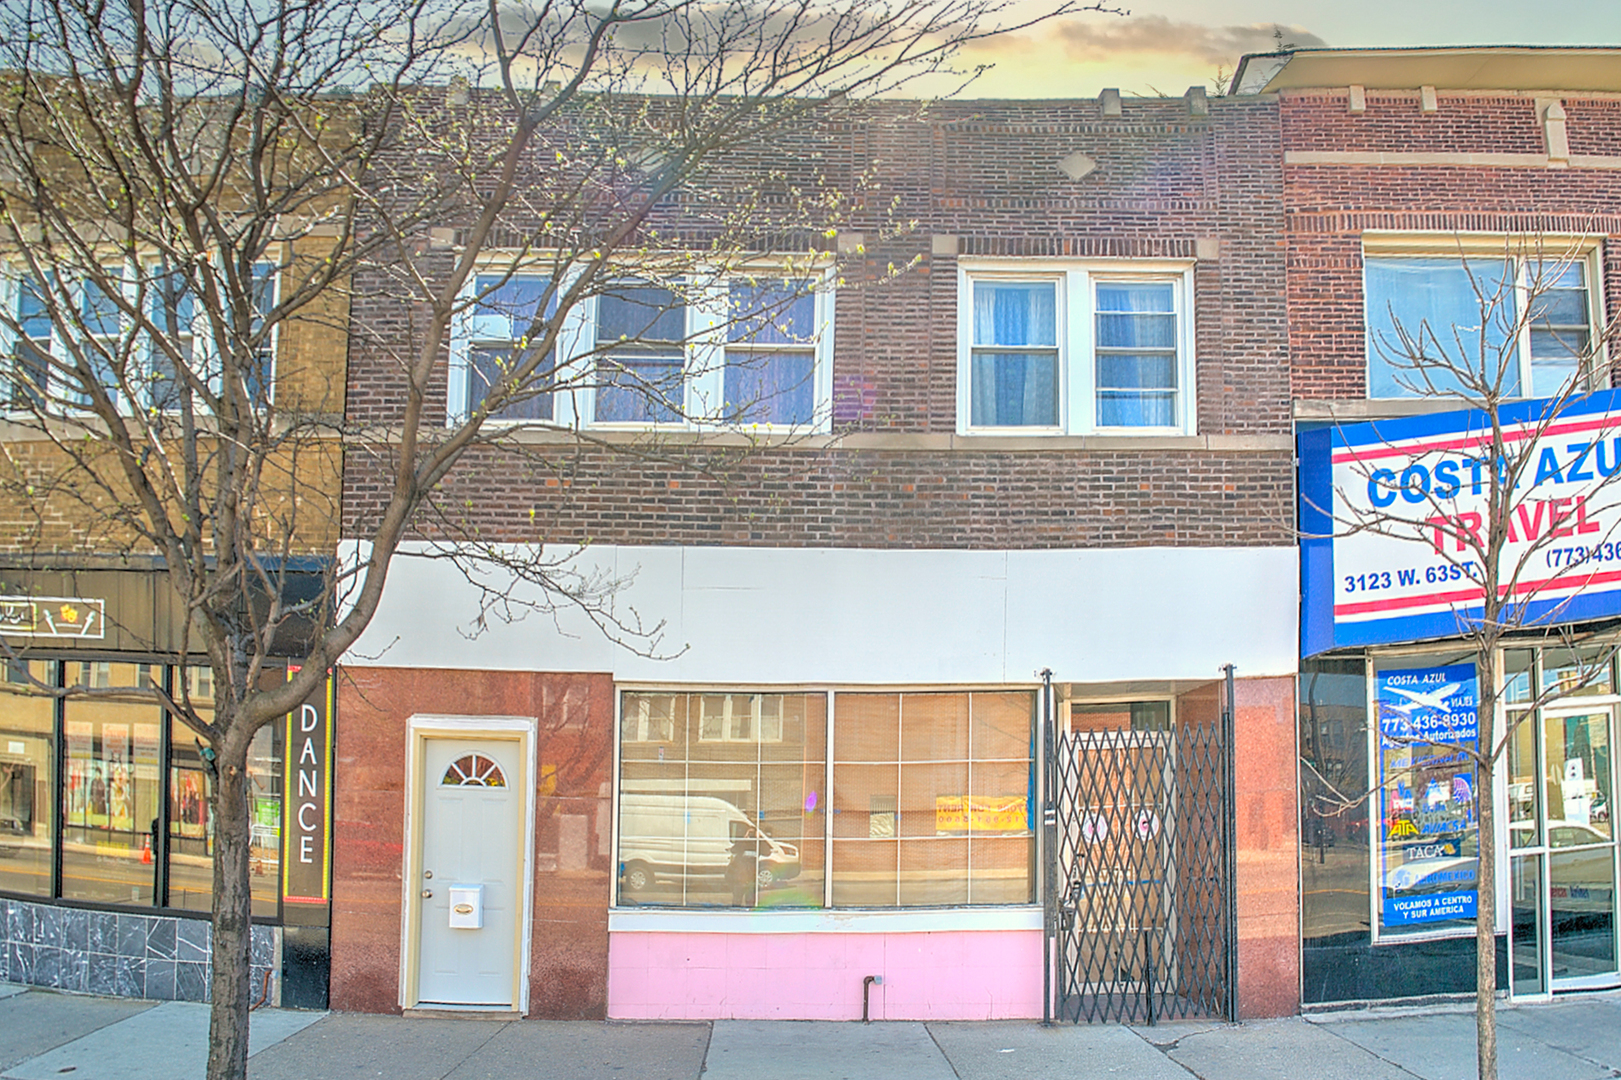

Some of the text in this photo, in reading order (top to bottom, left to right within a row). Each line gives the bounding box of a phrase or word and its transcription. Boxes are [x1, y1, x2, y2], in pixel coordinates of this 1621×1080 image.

[1344, 571, 1392, 593] 3123
[1397, 568, 1421, 587] W.
[1386, 672, 1447, 686] COSTA AZUL
[1450, 695, 1473, 707] VIAJES
[1423, 728, 1476, 742] Autorizados
[298, 704, 319, 864] DANCE
[1406, 844, 1444, 860] TACA
[1441, 895, 1473, 906] CENTRO
[1411, 909, 1428, 919] SUR
[1429, 904, 1464, 916] AMERICA
